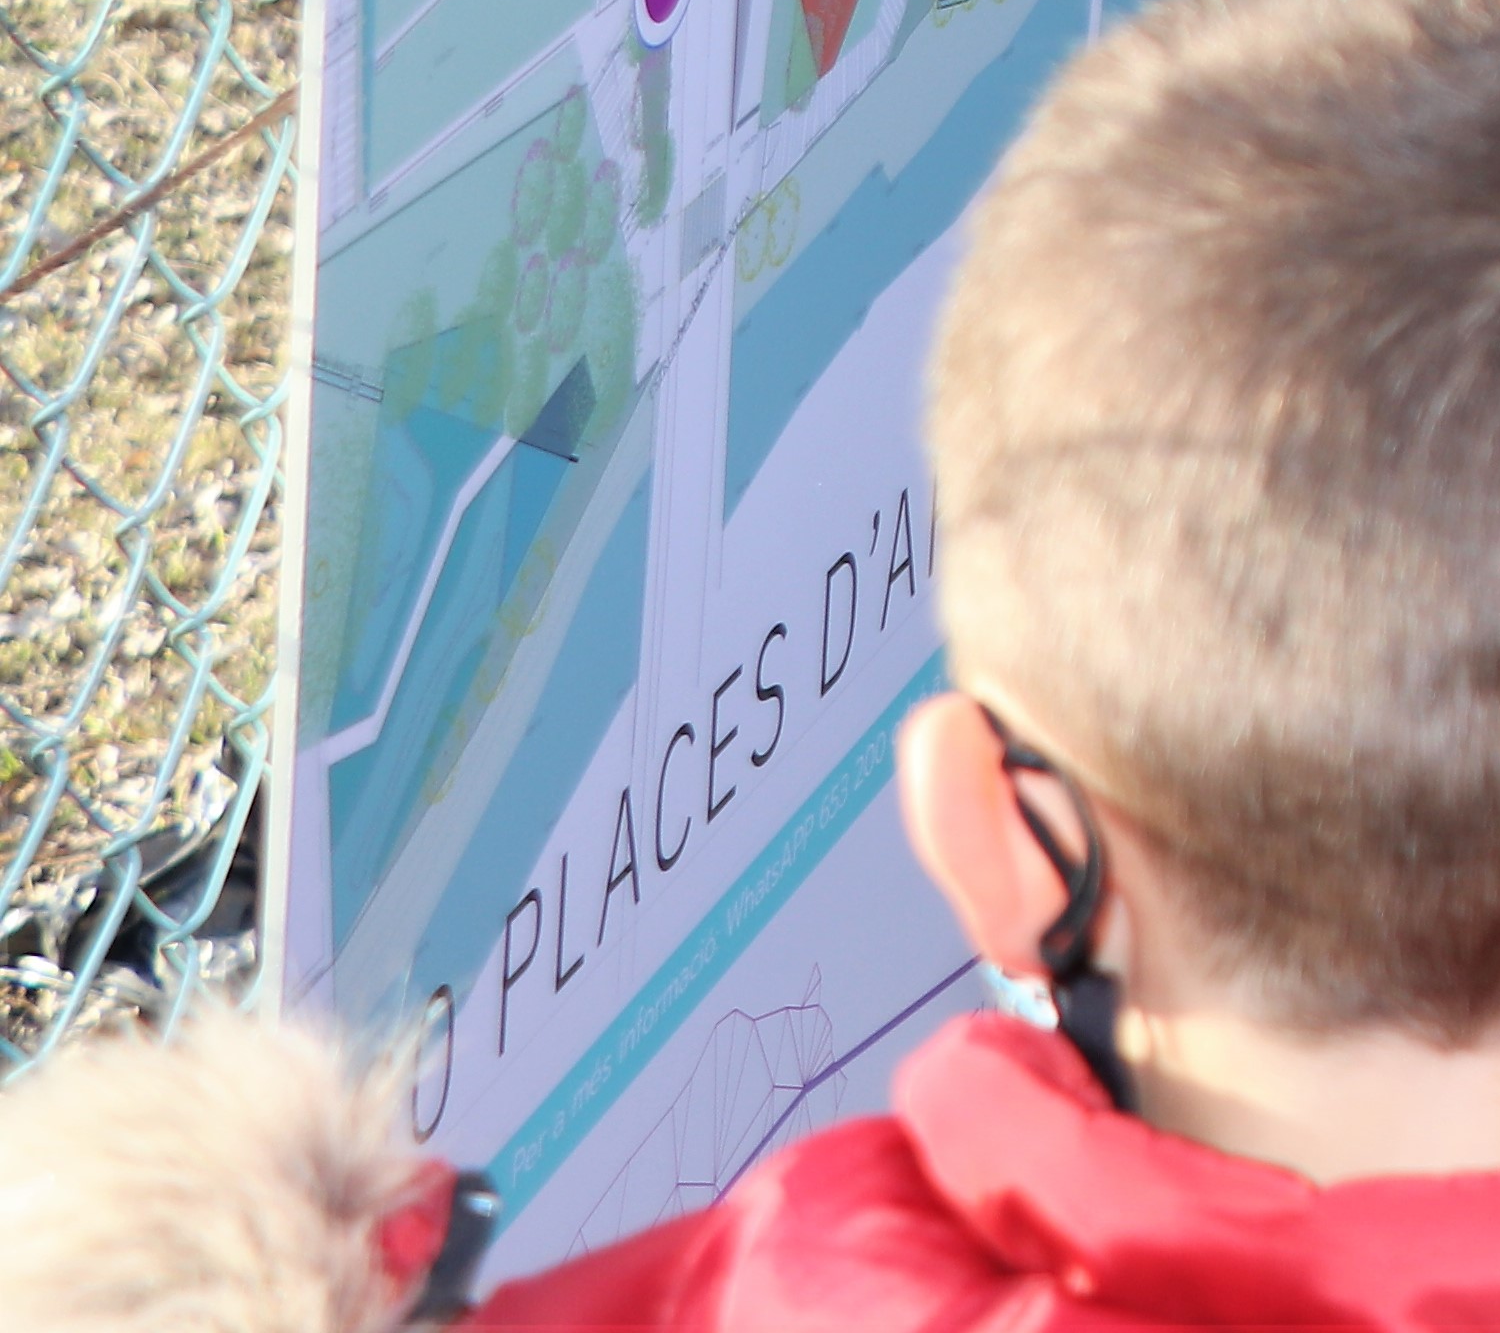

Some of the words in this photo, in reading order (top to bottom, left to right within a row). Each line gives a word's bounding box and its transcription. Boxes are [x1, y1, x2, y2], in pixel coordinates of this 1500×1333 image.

[497, 621, 788, 1058] PLACES
[820, 471, 938, 699] D'A
[511, 1131, 546, 1189] Per
[551, 1110, 566, 1140] a
[571, 1054, 612, 1118] més
